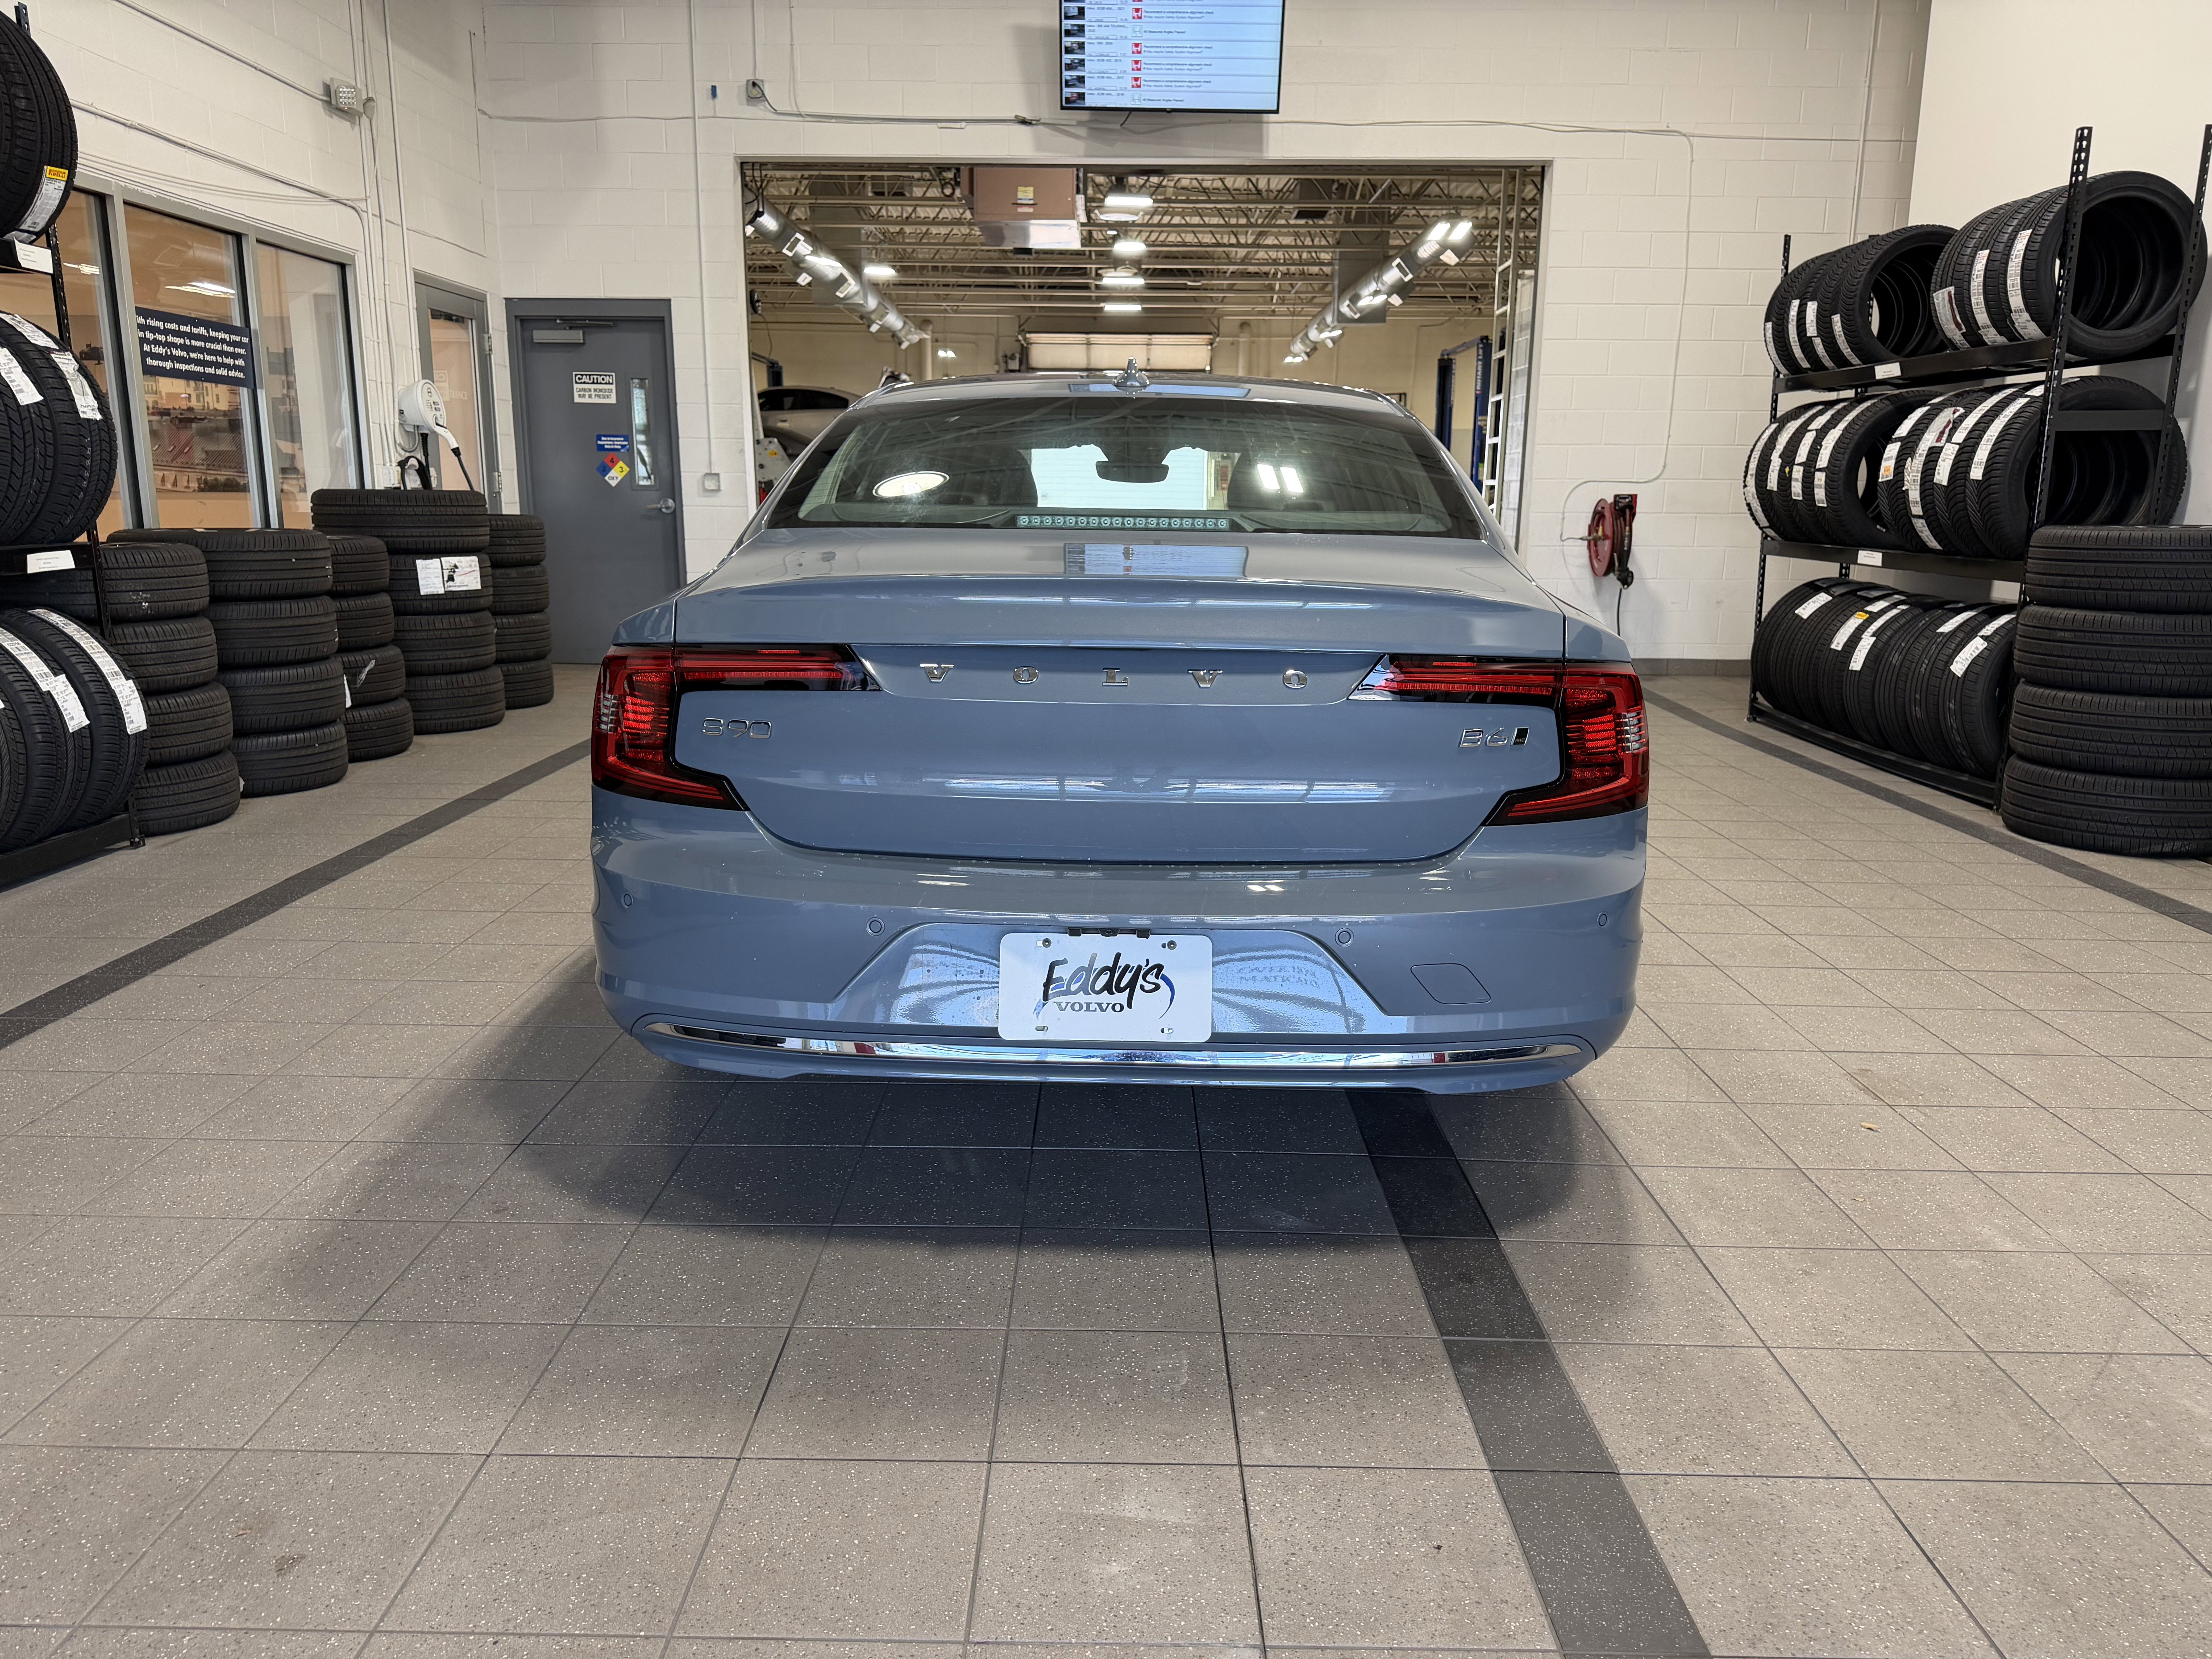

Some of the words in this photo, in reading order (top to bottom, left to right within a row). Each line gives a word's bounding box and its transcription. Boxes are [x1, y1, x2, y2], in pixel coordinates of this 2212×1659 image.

[48, 169, 66, 178] PIRELLI
[136, 315, 145, 325] ith
[146, 317, 163, 329] rising
[180, 324, 190, 332] and
[191, 326, 209, 337] tariffs,
[210, 328, 230, 341] keeping
[138, 329, 144, 338] in
[145, 330, 165, 343] tip-top
[167, 334, 184, 345] shape
[185, 337, 190, 345] is
[206, 342, 222, 350] crucial
[223, 343, 234, 352] than
[144, 343, 150, 352] At
[151, 344, 170, 356] Eddy's
[171, 347, 189, 359] Volvo,
[189, 351, 203, 360] we're
[204, 352, 216, 362] here
[223, 355, 234, 366] help
[235, 358, 245, 366] with
[146, 357, 173, 369] thorough
[174, 361, 204, 372] inspections
[216, 367, 227, 376] solid
[228, 369, 245, 378] advice.
[576, 375, 613, 383] CAUTION
[919, 663, 1308, 689] VOLVO
[702, 718, 771, 738] S90
[1458, 727, 1509, 748] B6
[1043, 952, 1164, 1010] Eddy's
[1054, 1001, 1124, 1013] VOLVO
